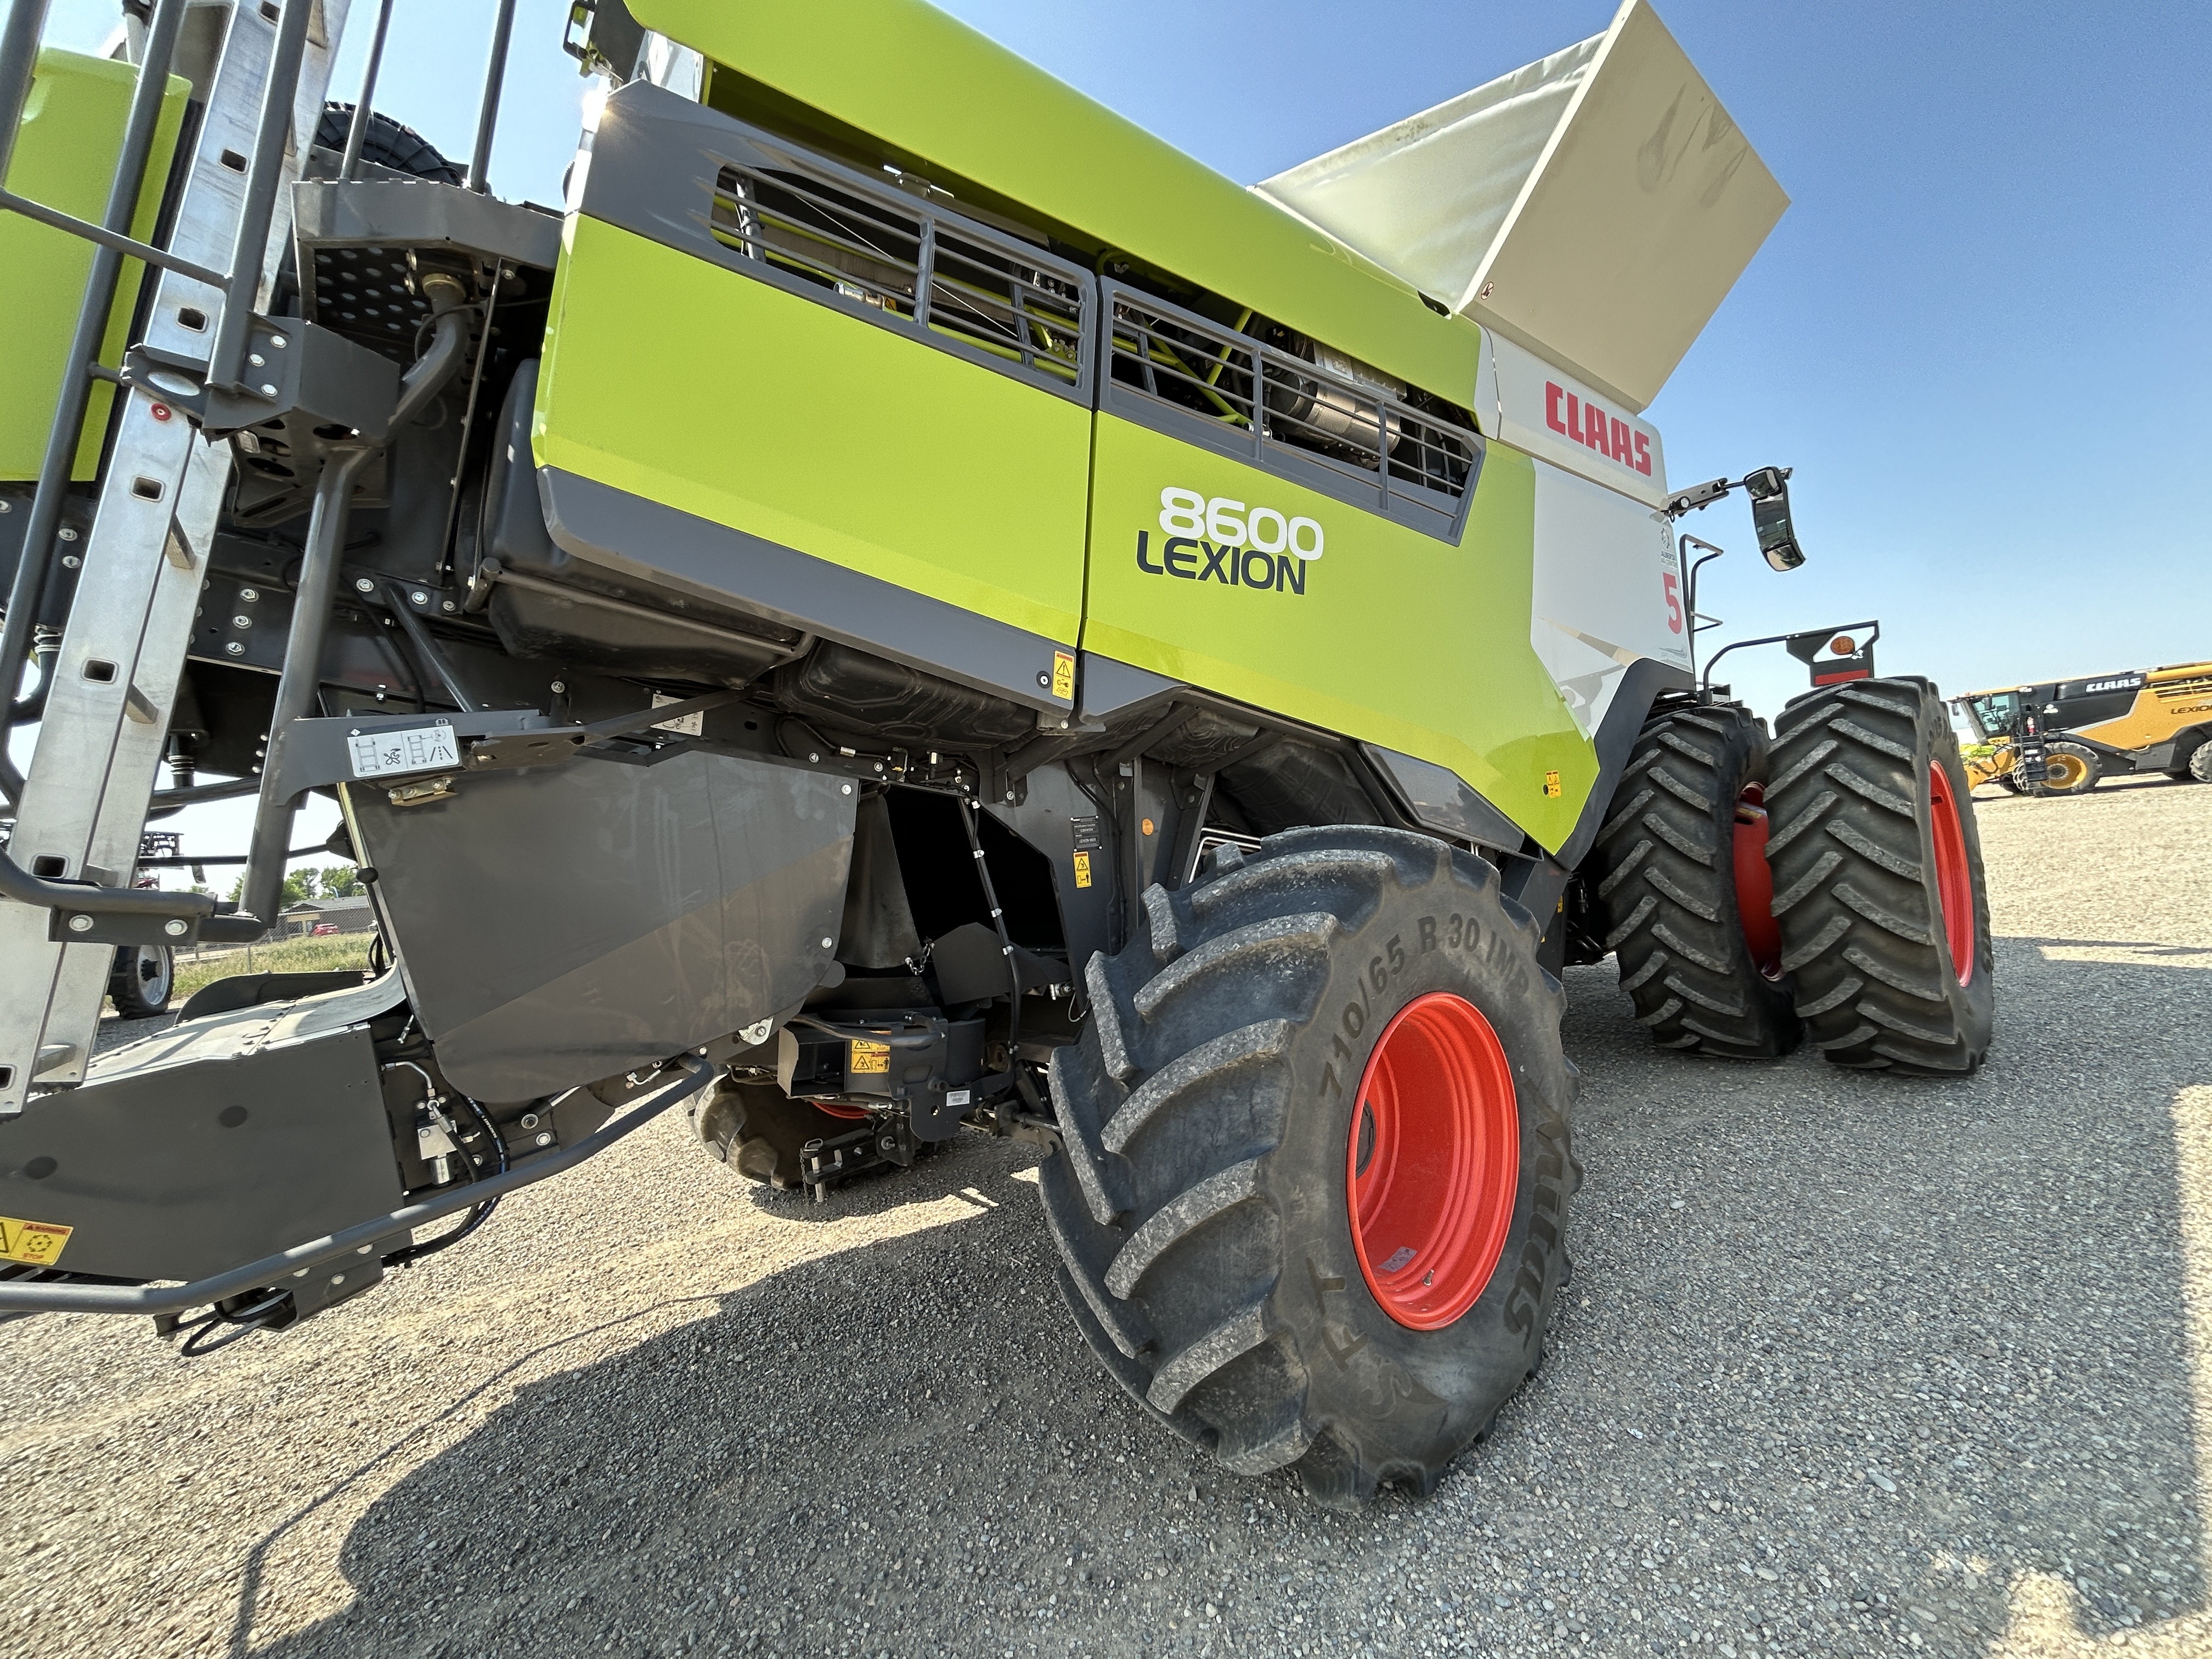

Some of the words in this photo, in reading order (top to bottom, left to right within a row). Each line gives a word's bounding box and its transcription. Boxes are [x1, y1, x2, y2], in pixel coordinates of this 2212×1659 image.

[1545, 380, 1652, 477] CLAAS
[1159, 487, 1324, 561] 8600
[1137, 530, 1307, 595] LEXION
[1662, 572, 1683, 635] 5
[2086, 678, 2141, 692] CLAAS
[1319, 934, 1406, 1099] 710/65
[1418, 916, 1437, 955] R
[1447, 913, 1480, 952] 30
